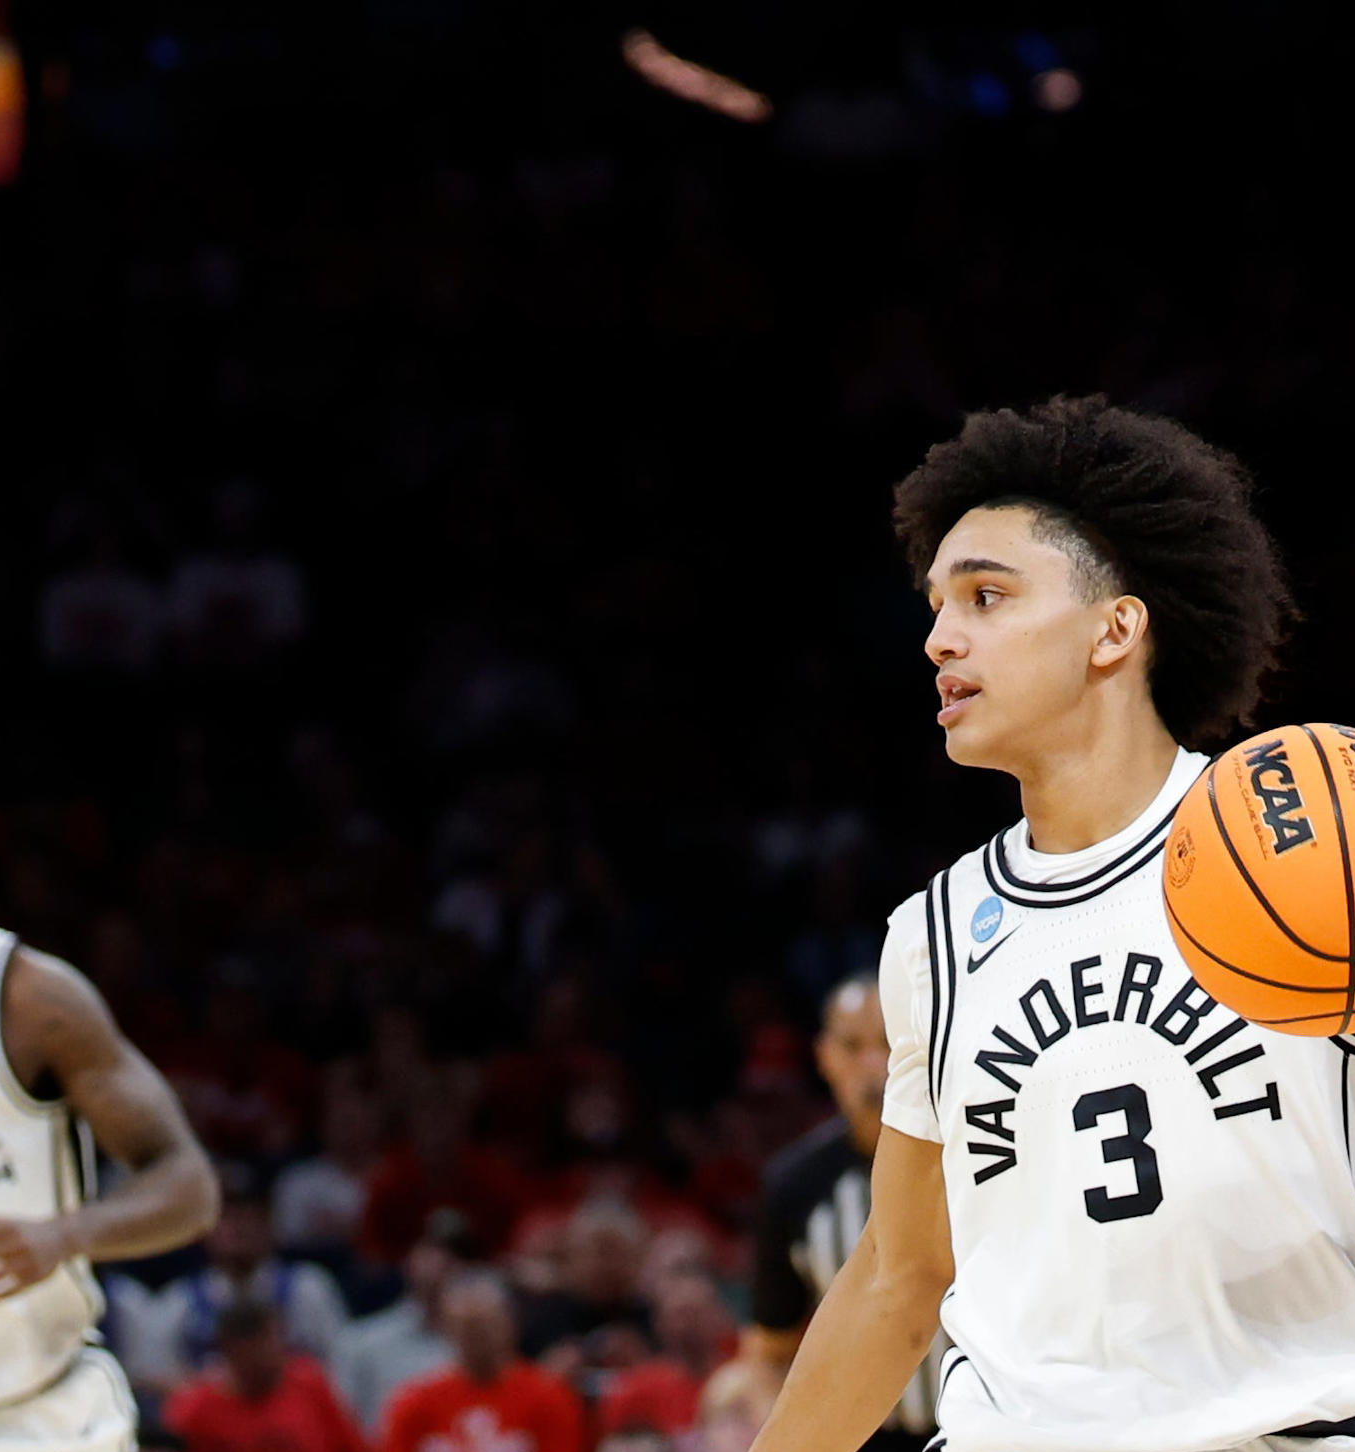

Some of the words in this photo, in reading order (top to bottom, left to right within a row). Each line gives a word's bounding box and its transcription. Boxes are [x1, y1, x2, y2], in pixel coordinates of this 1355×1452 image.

[1243, 739, 1315, 855] NCAA
[965, 952, 1282, 1186] VANDERBILT
[1071, 1083, 1164, 1224] 3
